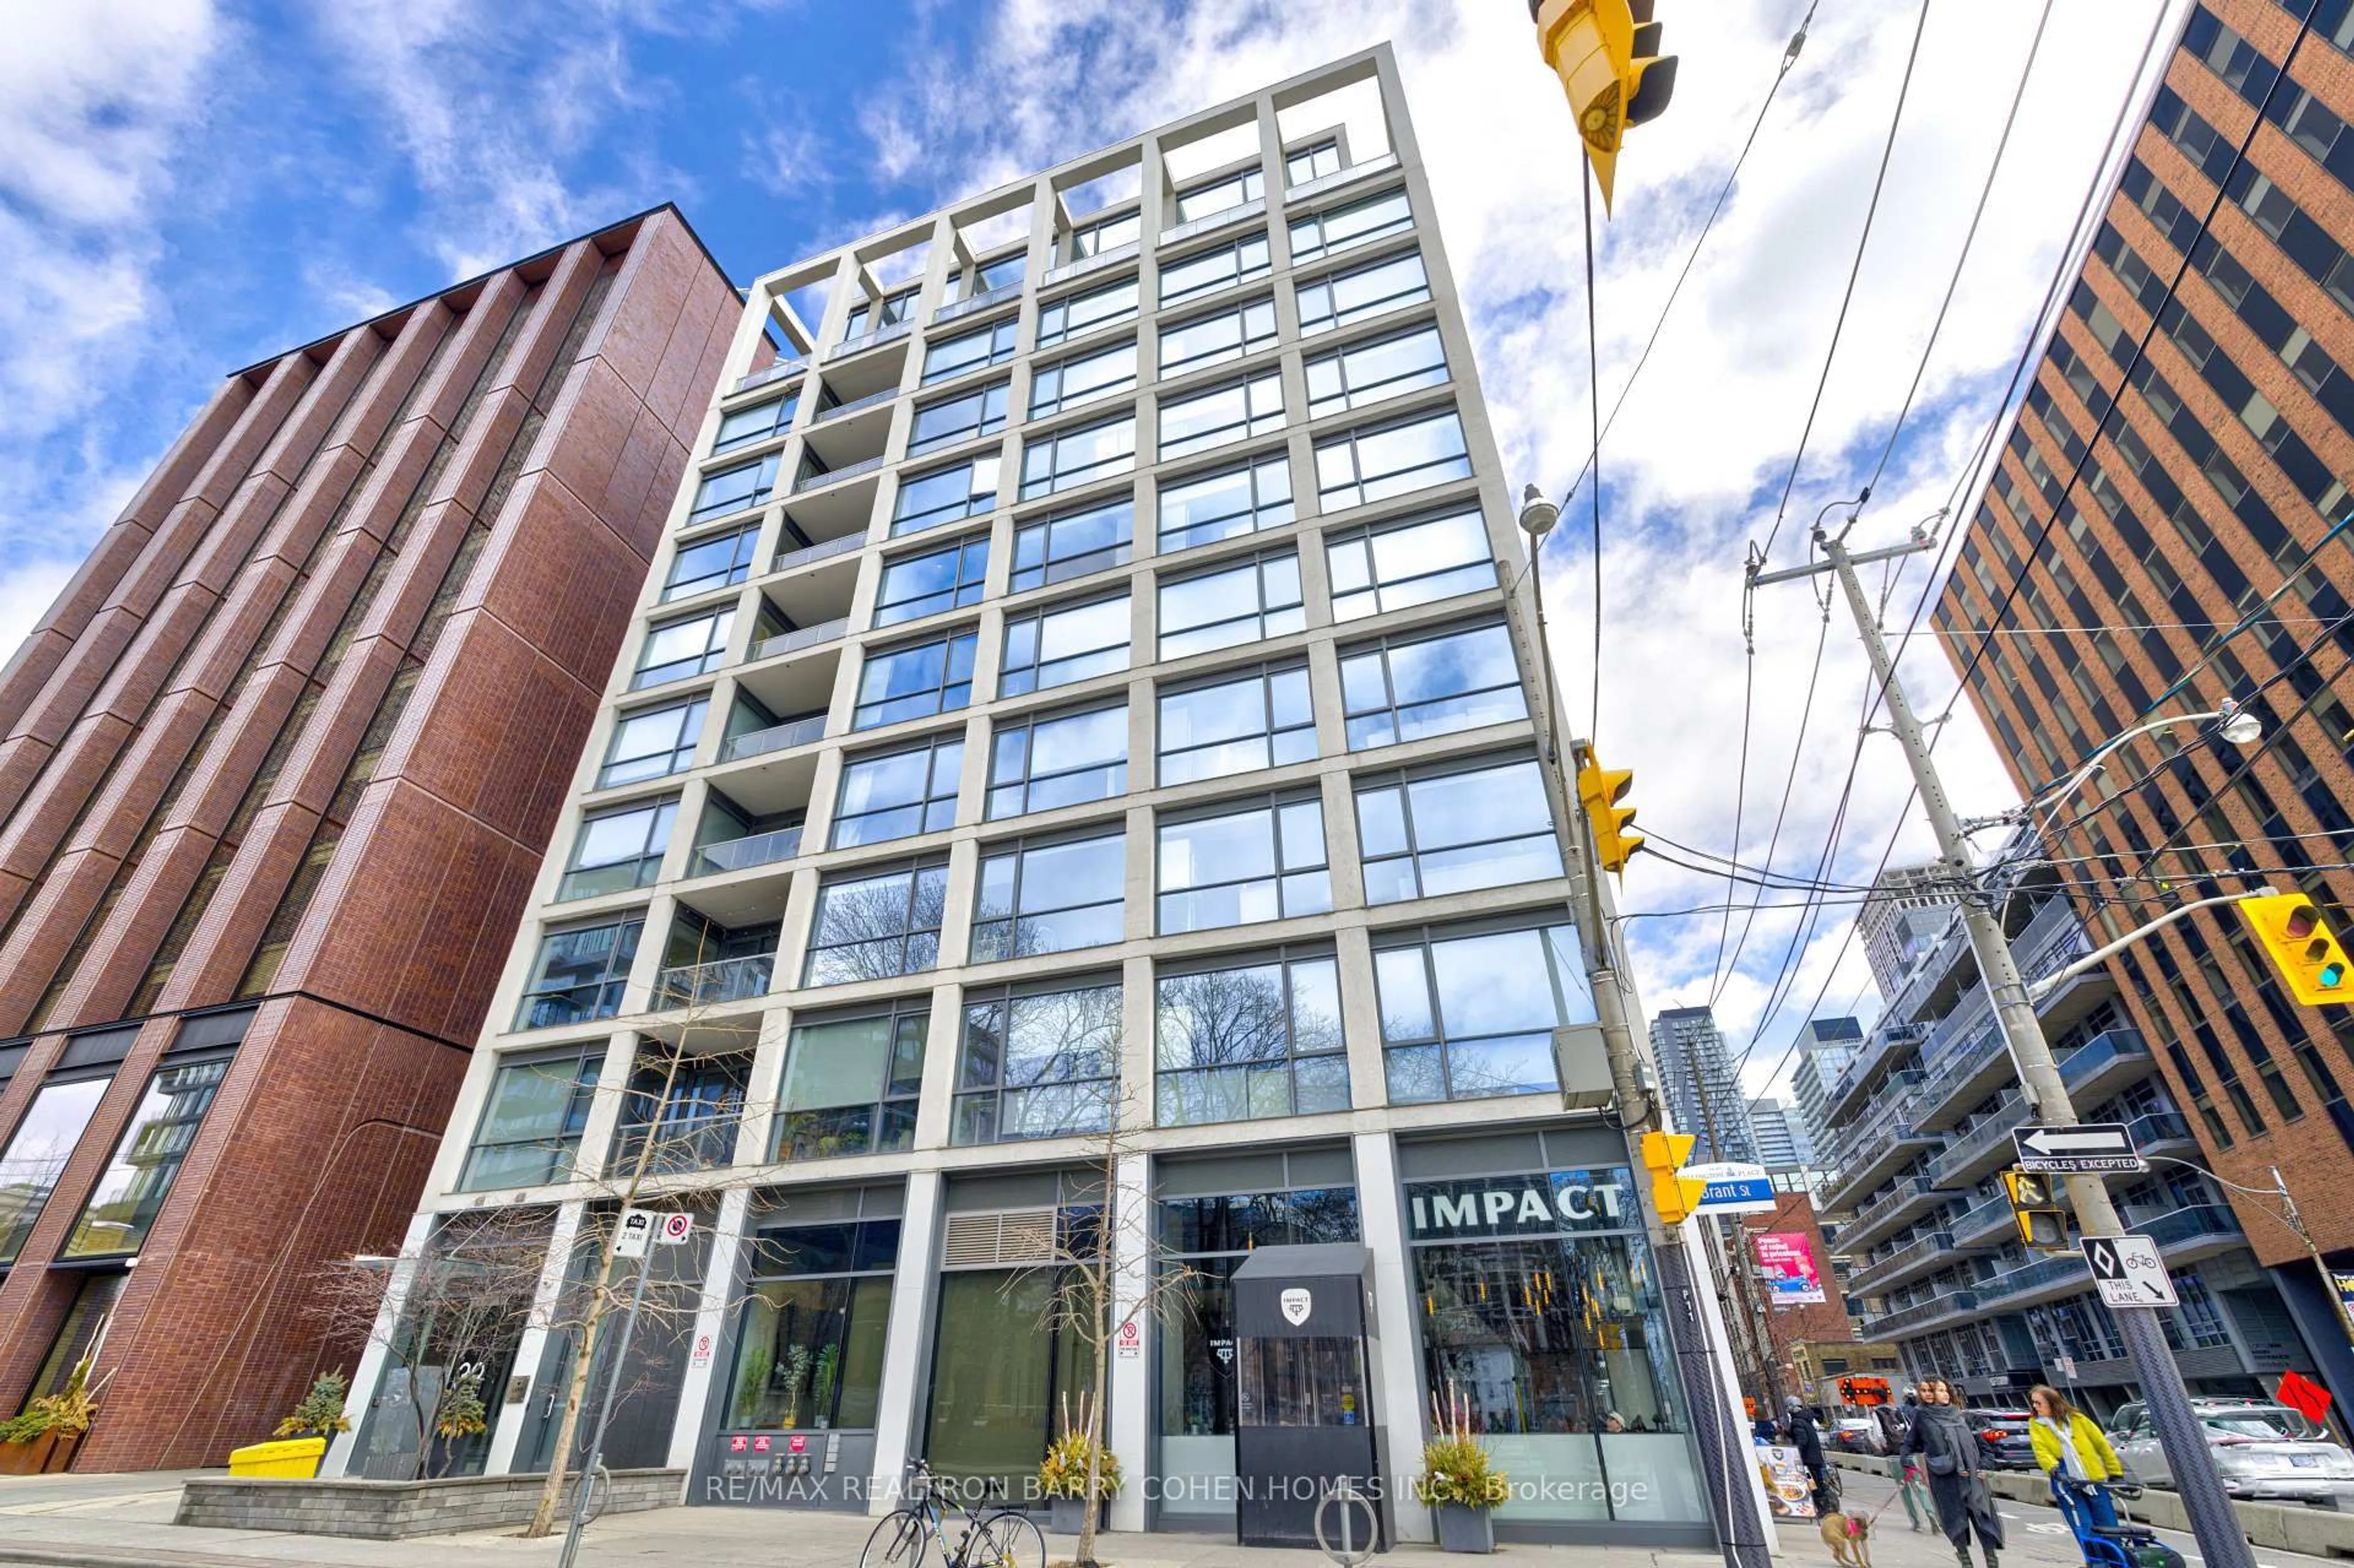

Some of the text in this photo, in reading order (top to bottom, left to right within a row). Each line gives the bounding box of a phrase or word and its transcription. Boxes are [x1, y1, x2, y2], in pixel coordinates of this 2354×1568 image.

[2025, 1159, 2138, 1170] BICYCLES EXCEPTED
[1740, 1184, 1751, 1196] St
[1412, 1184, 1623, 1229] IMPACT
[2108, 1281, 2133, 1290] THIS
[2110, 1292, 2139, 1303] LANE
